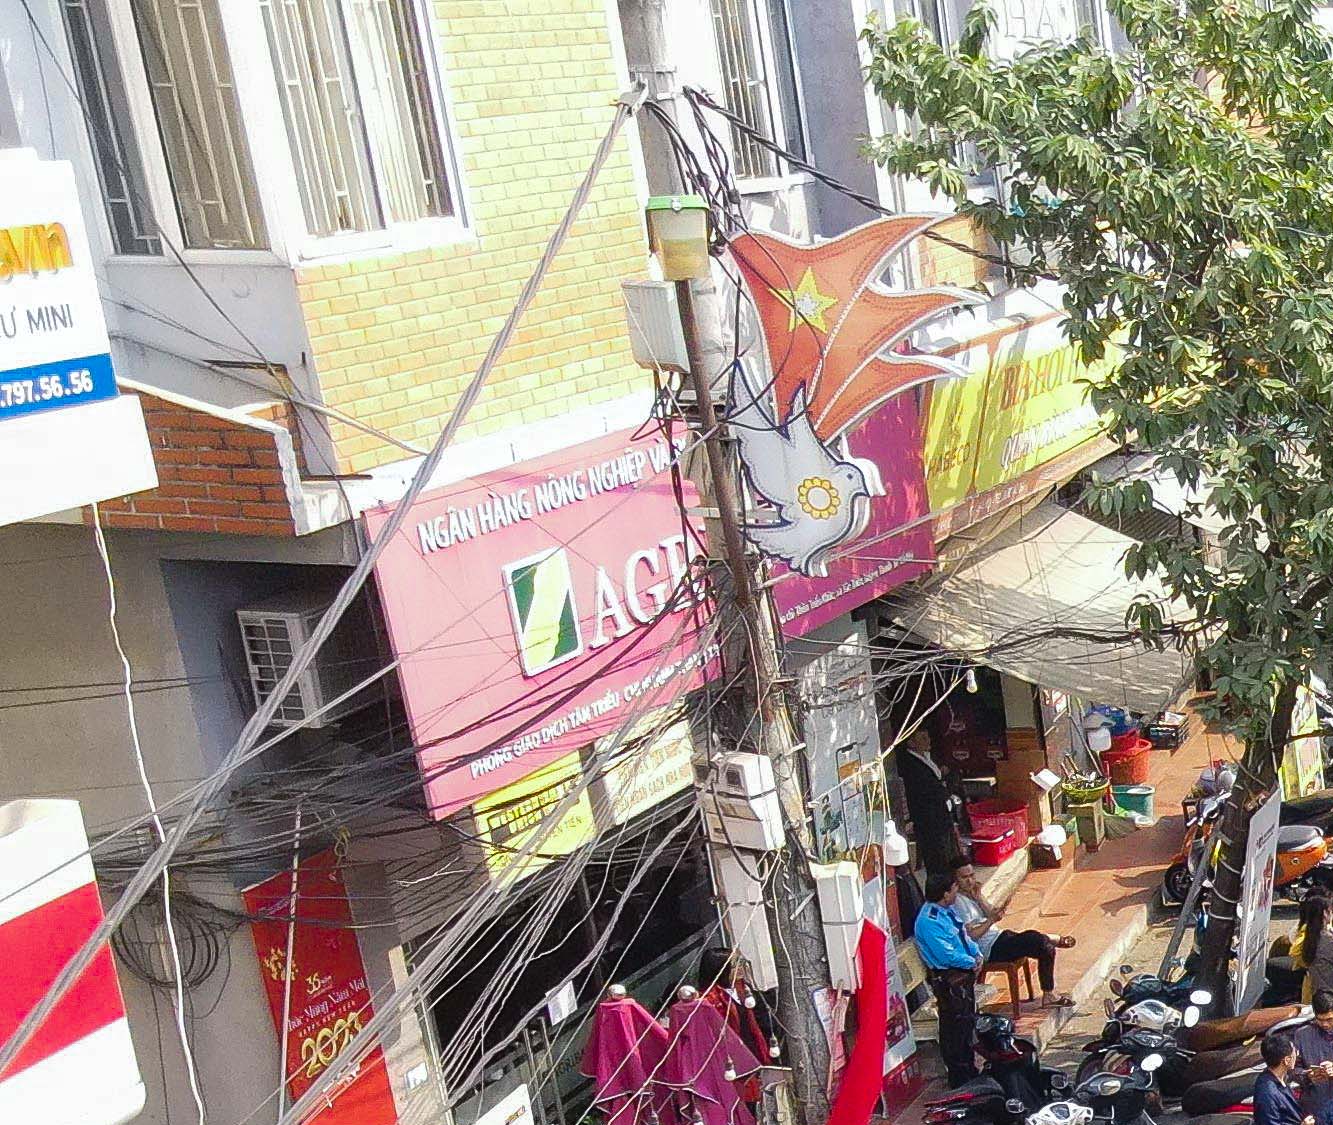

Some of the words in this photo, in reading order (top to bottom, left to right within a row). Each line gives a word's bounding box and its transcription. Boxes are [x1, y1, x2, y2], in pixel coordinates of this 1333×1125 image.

[26, 302, 74, 334] MINI
[417, 506, 475, 556] NGÂN
[477, 491, 533, 534] HÀNG
[533, 473, 588, 513] NÔNG
[589, 450, 648, 495] NGHIỆP
